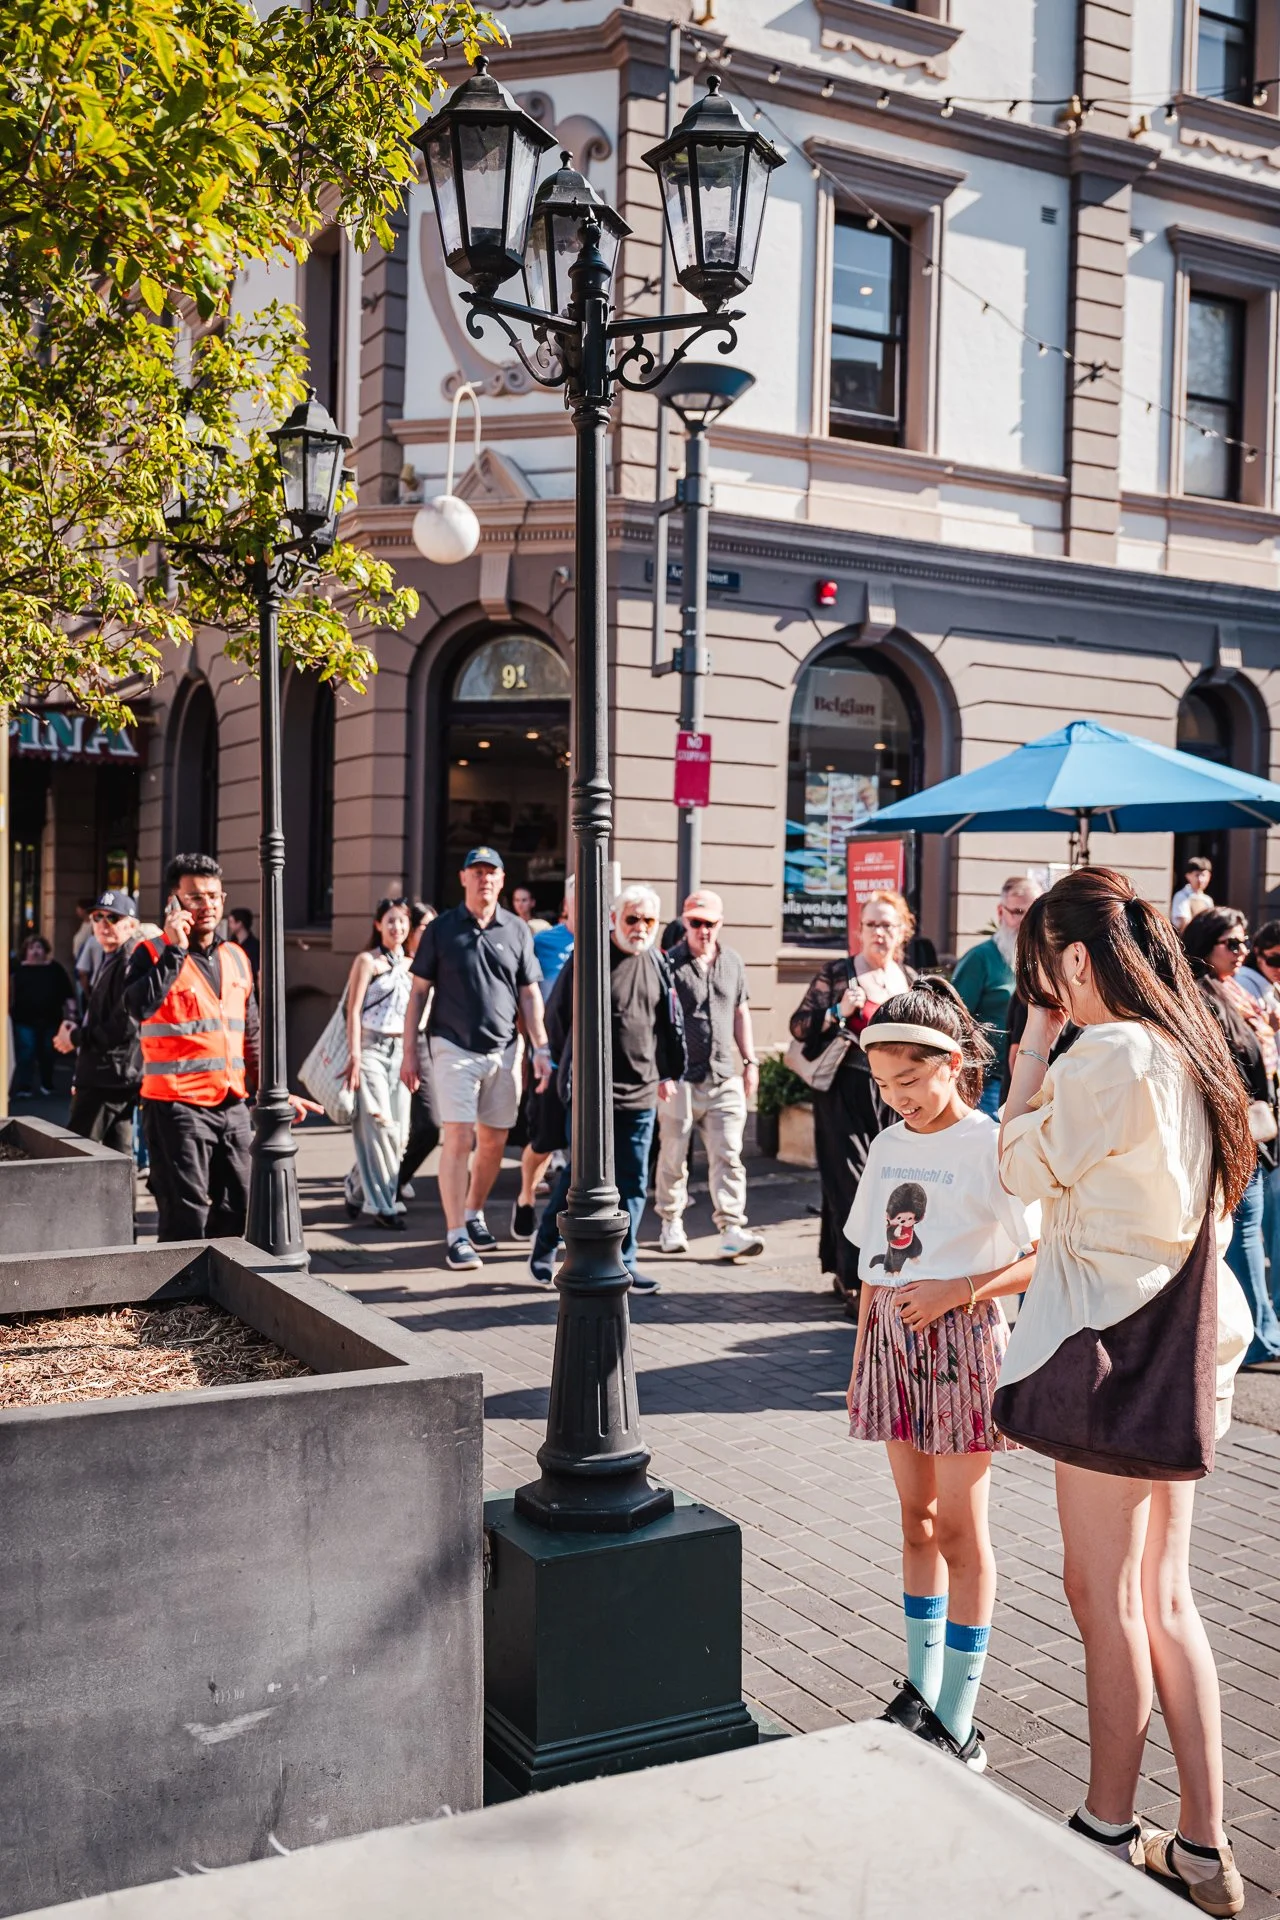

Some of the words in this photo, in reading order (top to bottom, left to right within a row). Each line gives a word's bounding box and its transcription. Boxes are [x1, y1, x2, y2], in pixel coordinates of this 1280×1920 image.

[502, 664, 528, 689] 91
[814, 696, 875, 717] Belgian
[687, 736, 703, 749] NO
[942, 1171, 954, 1184] is
